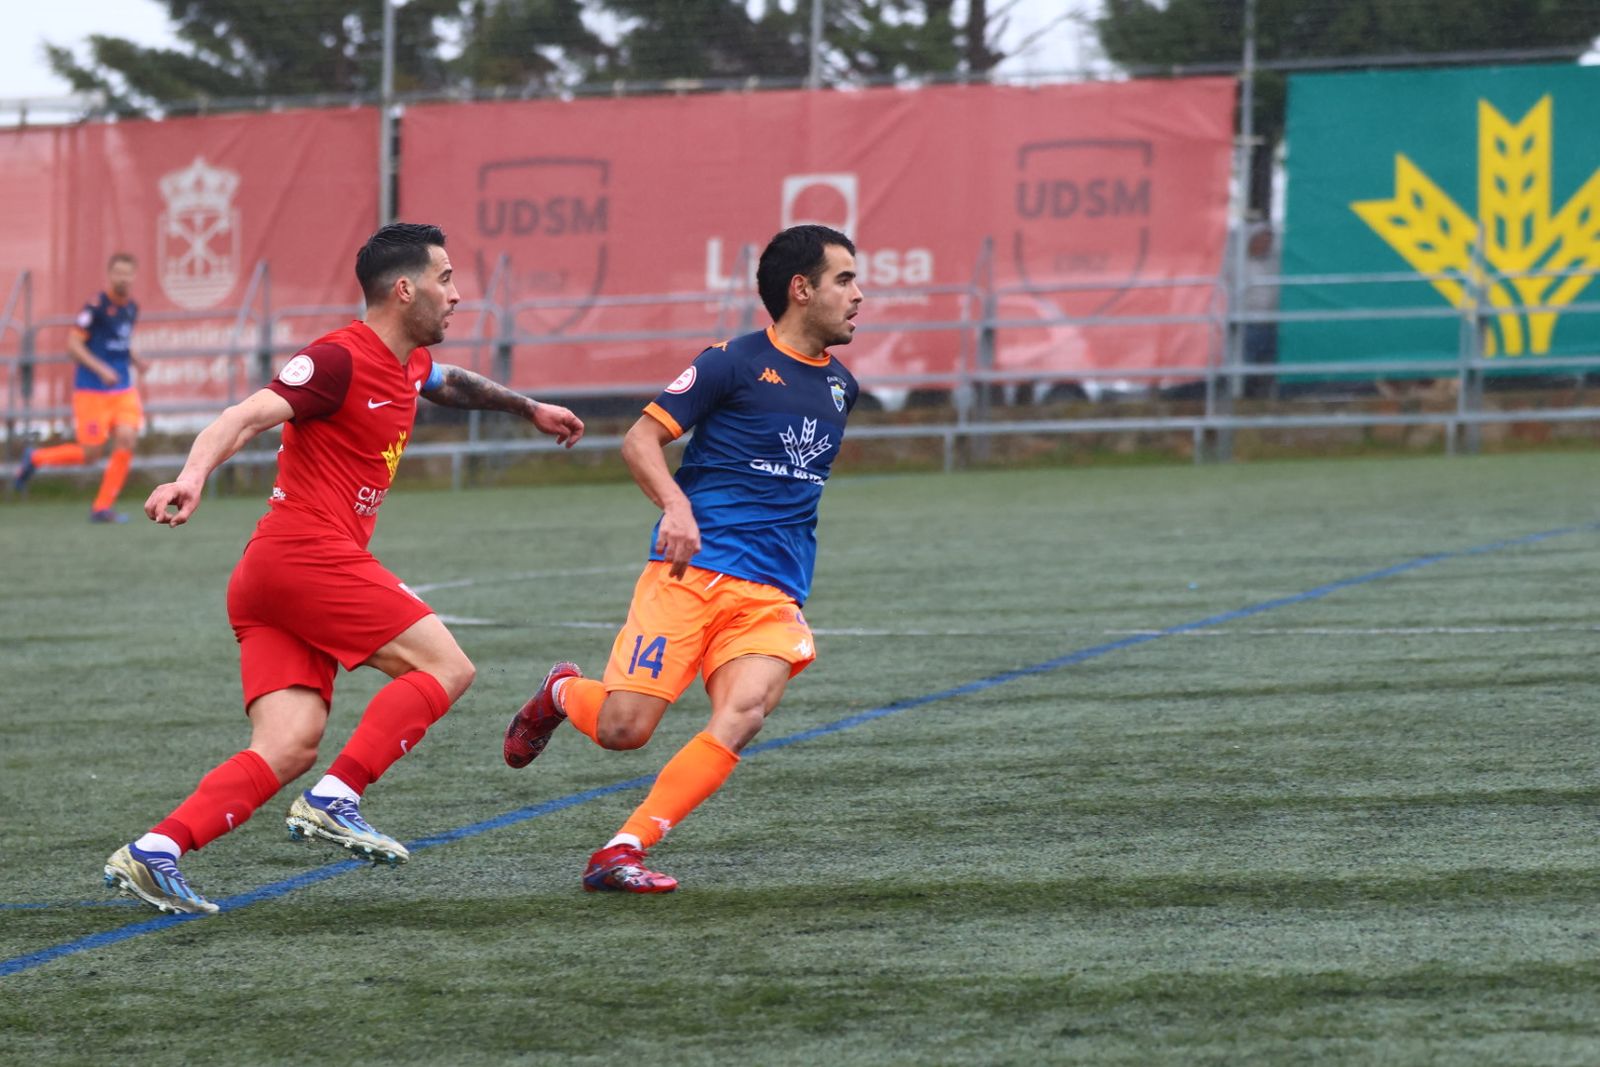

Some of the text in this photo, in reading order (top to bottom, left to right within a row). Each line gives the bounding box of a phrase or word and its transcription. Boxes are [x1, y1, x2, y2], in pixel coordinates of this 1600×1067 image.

[477, 196, 609, 238] UDSM
[1016, 178, 1151, 219] UDSM
[628, 634, 667, 679] 14
